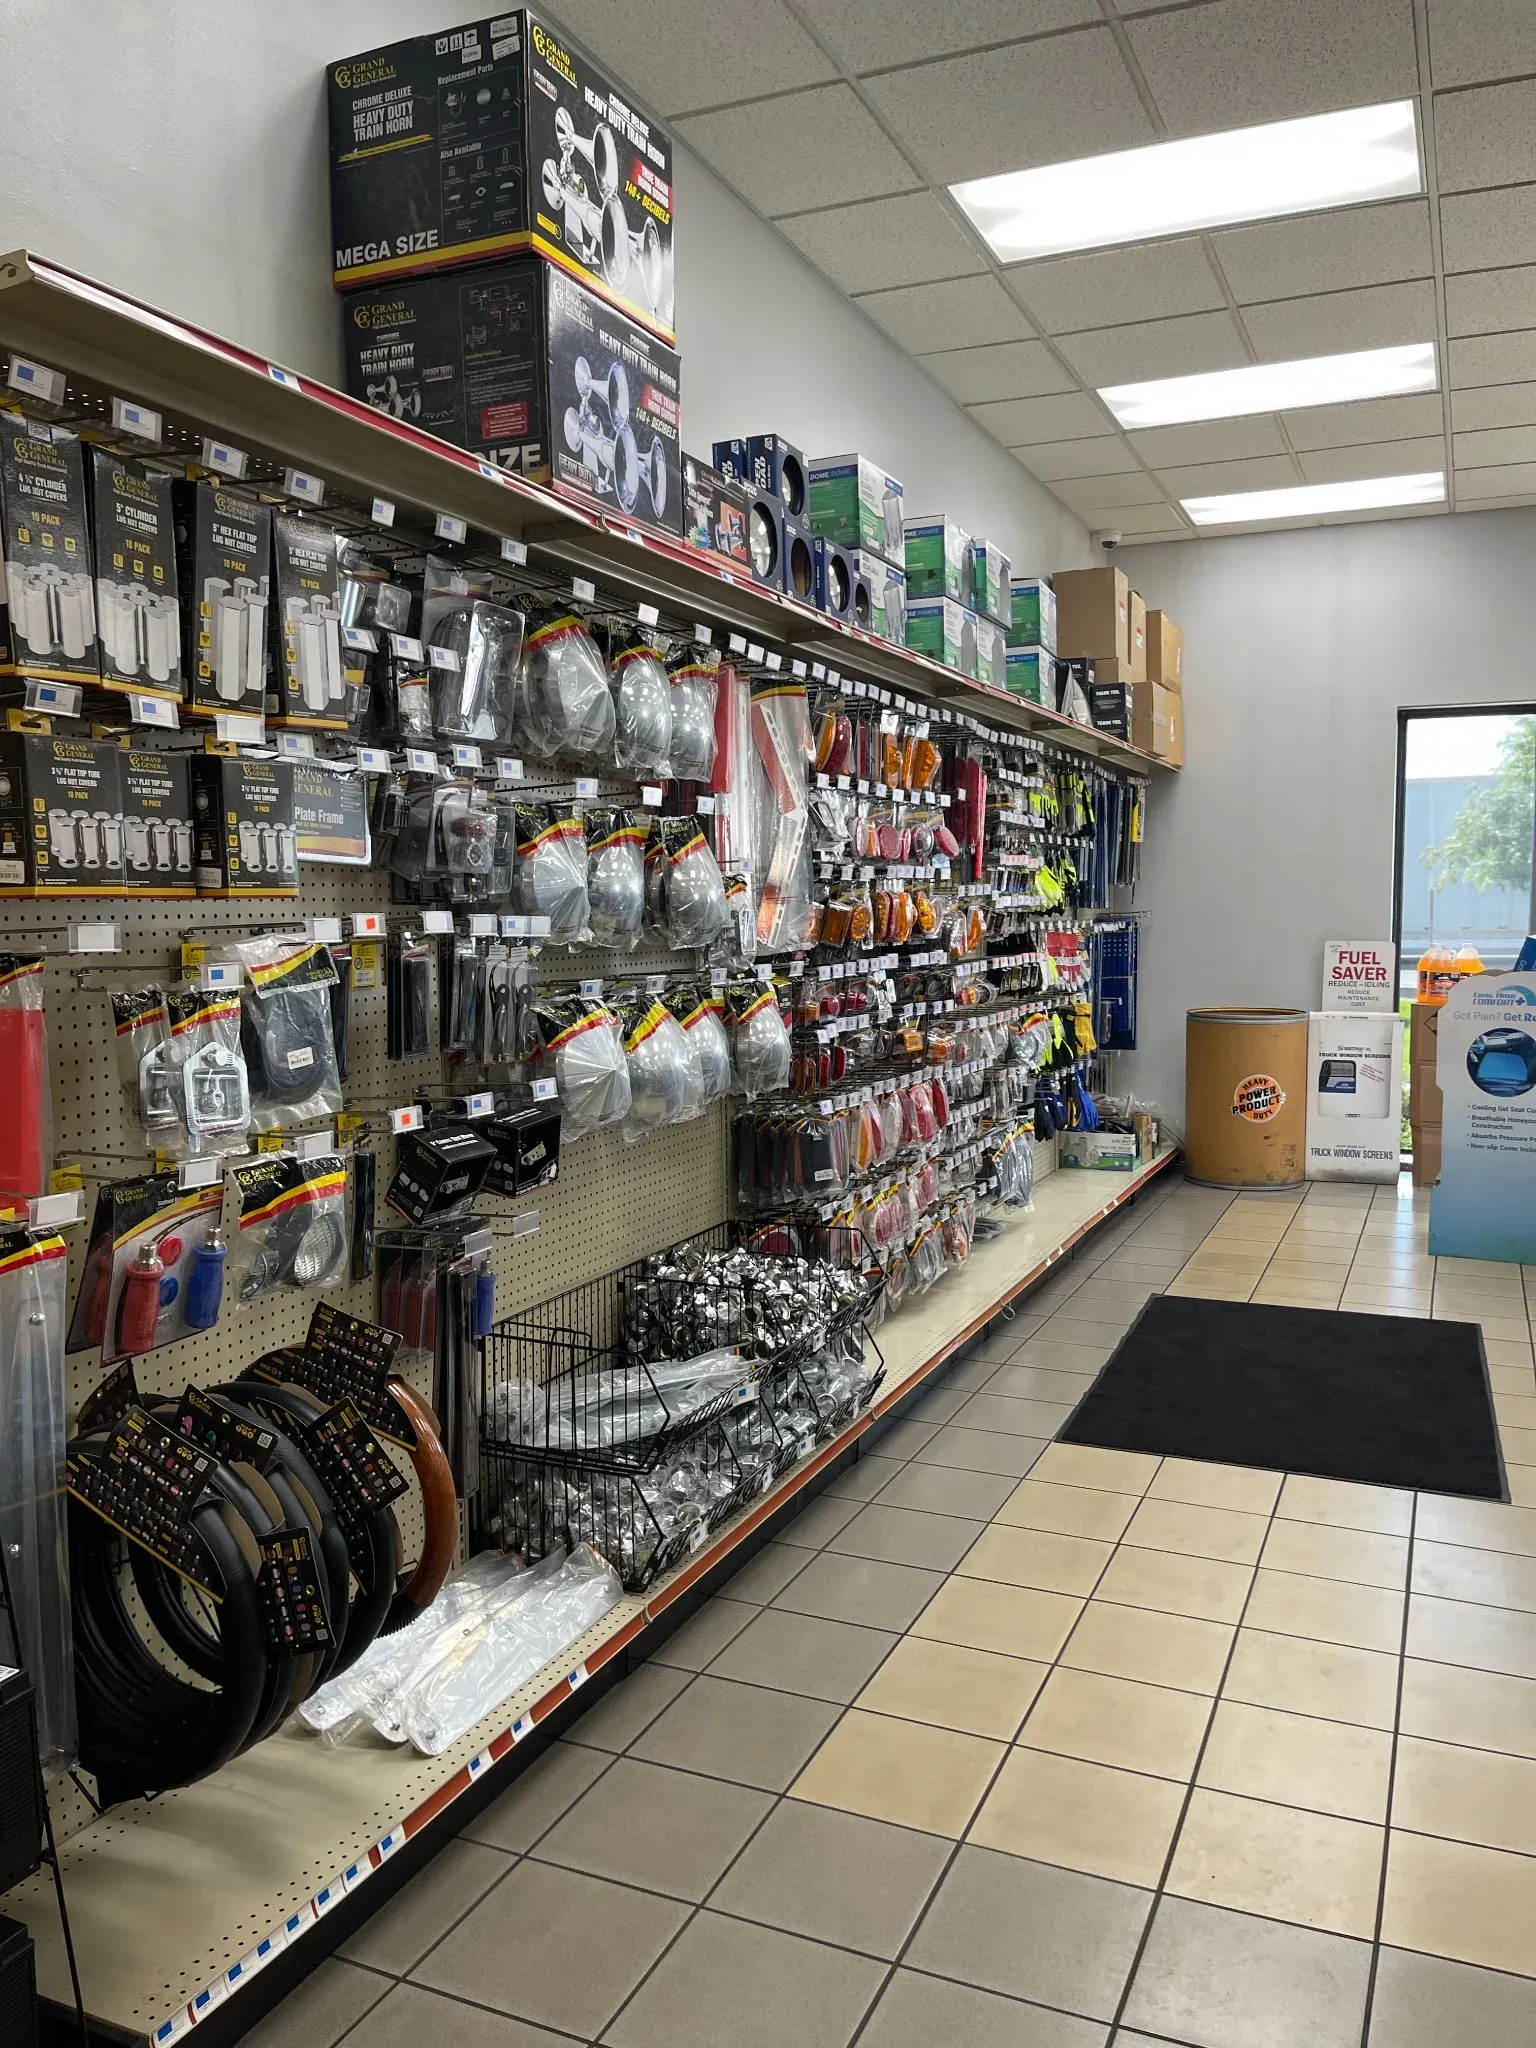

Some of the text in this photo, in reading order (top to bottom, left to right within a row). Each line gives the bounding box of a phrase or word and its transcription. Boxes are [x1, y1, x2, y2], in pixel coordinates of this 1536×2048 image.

[546, 38, 570, 66] GRAND
[353, 58, 385, 73] GRAND
[546, 50, 578, 83] GENERAL
[353, 65, 397, 83] GENERAL
[437, 63, 494, 85] Replacement Parts
[353, 86, 412, 111] CHROME DELUXE
[609, 92, 630, 121] CHROME
[353, 100, 414, 129] HEAVY DUTY
[353, 115, 413, 142] TRAIN HORN
[584, 85, 607, 118] HEAVY
[608, 105, 626, 135] DUTY
[627, 121, 647, 154] TRAIN
[647, 141, 665, 170] HORN
[440, 149, 453, 160] Also
[454, 141, 482, 156] Available
[642, 194, 670, 225] DECIBELS
[336, 229, 439, 268] MEGA SIZE
[372, 301, 405, 315] GRAND
[372, 310, 417, 326] GENERAL
[360, 343, 415, 363] HEAVY DUTY
[361, 356, 415, 376] TRAIN HORN
[599, 329, 677, 393] HEAVY DUTY TRAIN HORN
[651, 417, 677, 440] DECIBELS
[29, 442, 58, 456] GRAND
[30, 450, 68, 469] GENERAL
[474, 444, 541, 476] IZE
[560, 455, 578, 476] HEAVY
[35, 476, 67, 493] CYLINDER
[126, 476, 151, 491] GRAND
[19, 483, 68, 502] LUG NUT COVERS
[126, 484, 158, 502] GENERAL
[31, 510, 61, 527] 10 PACK
[125, 505, 158, 526] CYLINDER
[116, 513, 158, 535] LUG NUT COVERS
[220, 525, 258, 544] HEX FLAT TOP
[125, 539, 151, 555] 10 PACK
[212, 533, 257, 554] LUG NUT COVERS
[295, 548, 327, 563] HEX FLAT TOP
[223, 558, 247, 573] 10 PACK
[289, 556, 299, 566] LUG
[309, 560, 328, 572] COVERS
[307, 579, 320, 590] PACK
[65, 743, 88, 752] GRAND
[65, 749, 95, 760] GENERAL
[140, 755, 162, 763] GRAND
[140, 761, 169, 770] GENERAL
[64, 768, 101, 779] FLAT TOP TUBE
[252, 764, 270, 772] GRAND
[252, 770, 276, 779] GENERAL
[56, 776, 97, 787] LUG NUT COVERS
[139, 778, 151, 787] FLAT
[161, 780, 174, 788] TUBE
[74, 791, 89, 800] PACK
[131, 786, 170, 796] LUG NUT COVERS
[261, 786, 270, 794] TOP
[148, 800, 162, 808] PACK
[294, 806, 344, 825] Plate Frame
[1338, 950, 1381, 965] FUEL
[1331, 966, 1387, 981] SAVER
[1328, 980, 1358, 988] REDUCE
[1472, 998, 1515, 1006] COMFORT
[1453, 1011, 1471, 1020] Got
[1473, 1011, 1501, 1021] Pain?
[1503, 1012, 1522, 1021] Get
[1242, 1078, 1269, 1091] HEAVY
[1238, 1085, 1277, 1103] POWER
[1253, 1109, 1273, 1119] DUTY
[1471, 1104, 1497, 1112] Cooling
[1471, 1114, 1506, 1122] Breathable
[1471, 1122, 1513, 1130] Construction
[1498, 1134, 1528, 1142] Pressure
[1310, 1147, 1393, 1160] TRUCK WINDOW SCREENS
[1470, 1143, 1518, 1152] Non-slip Cover
[254, 1170, 282, 1182] GENERAL
[124, 1187, 144, 1196] GRAND
